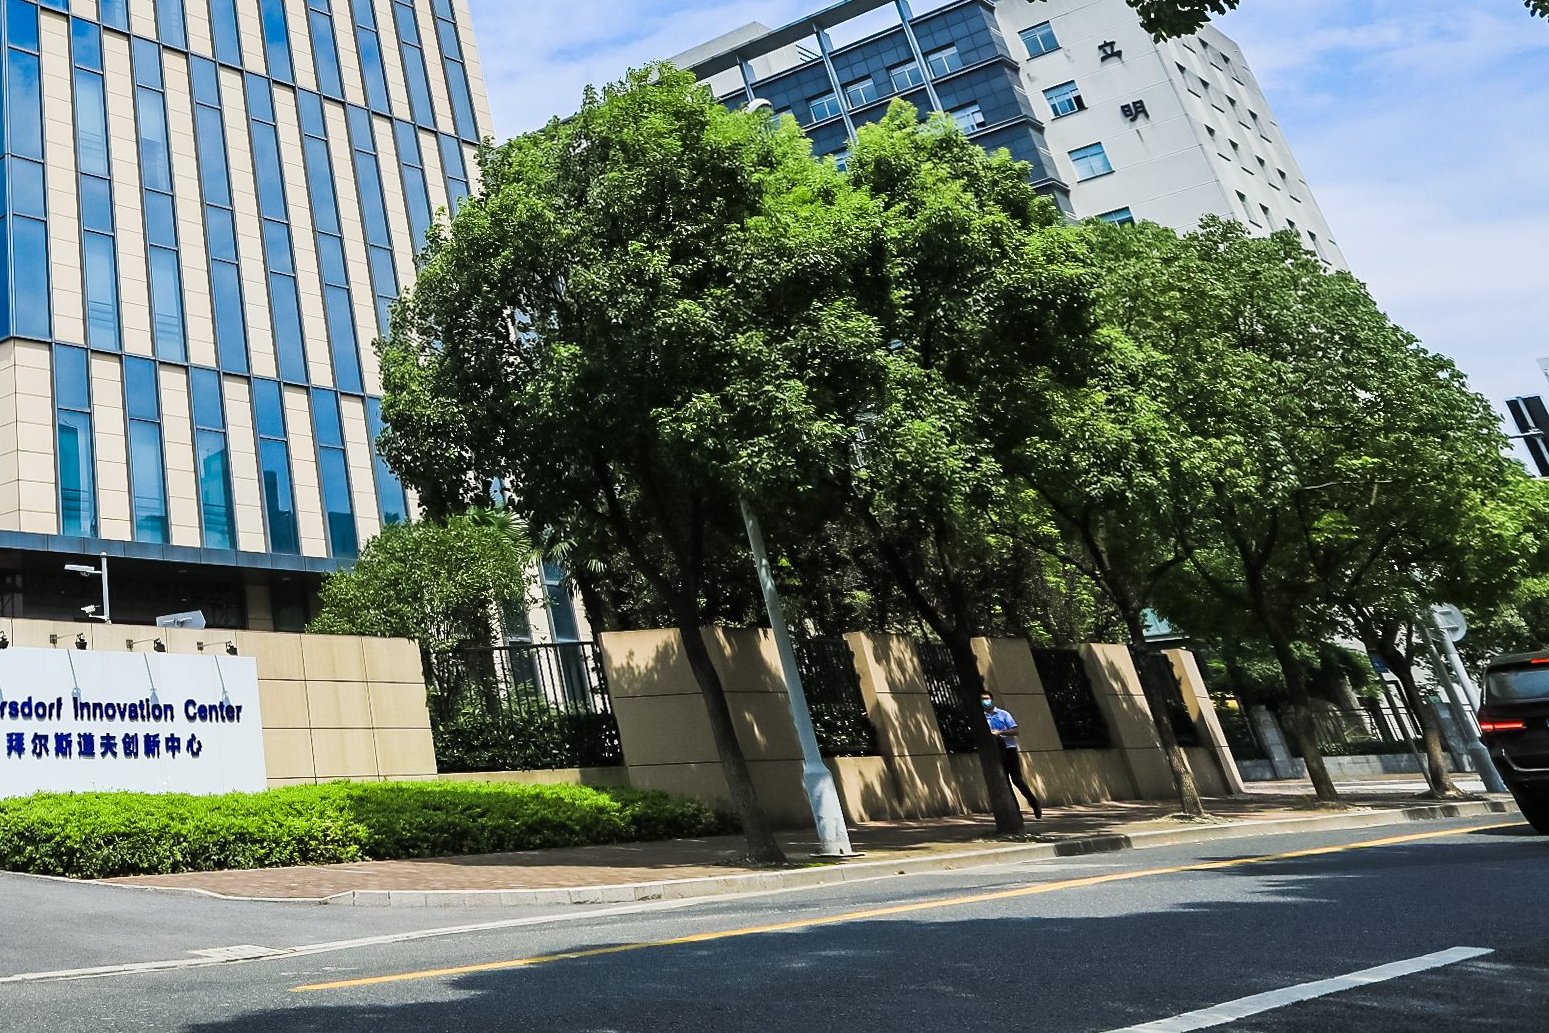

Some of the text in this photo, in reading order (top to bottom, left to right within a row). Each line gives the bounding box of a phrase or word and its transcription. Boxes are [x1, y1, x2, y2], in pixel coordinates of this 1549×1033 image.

[73, 696, 175, 722] Innovation
[184, 699, 242, 723] Center
[6, 732, 202, 760] 拜尔斯道夫创新中心
